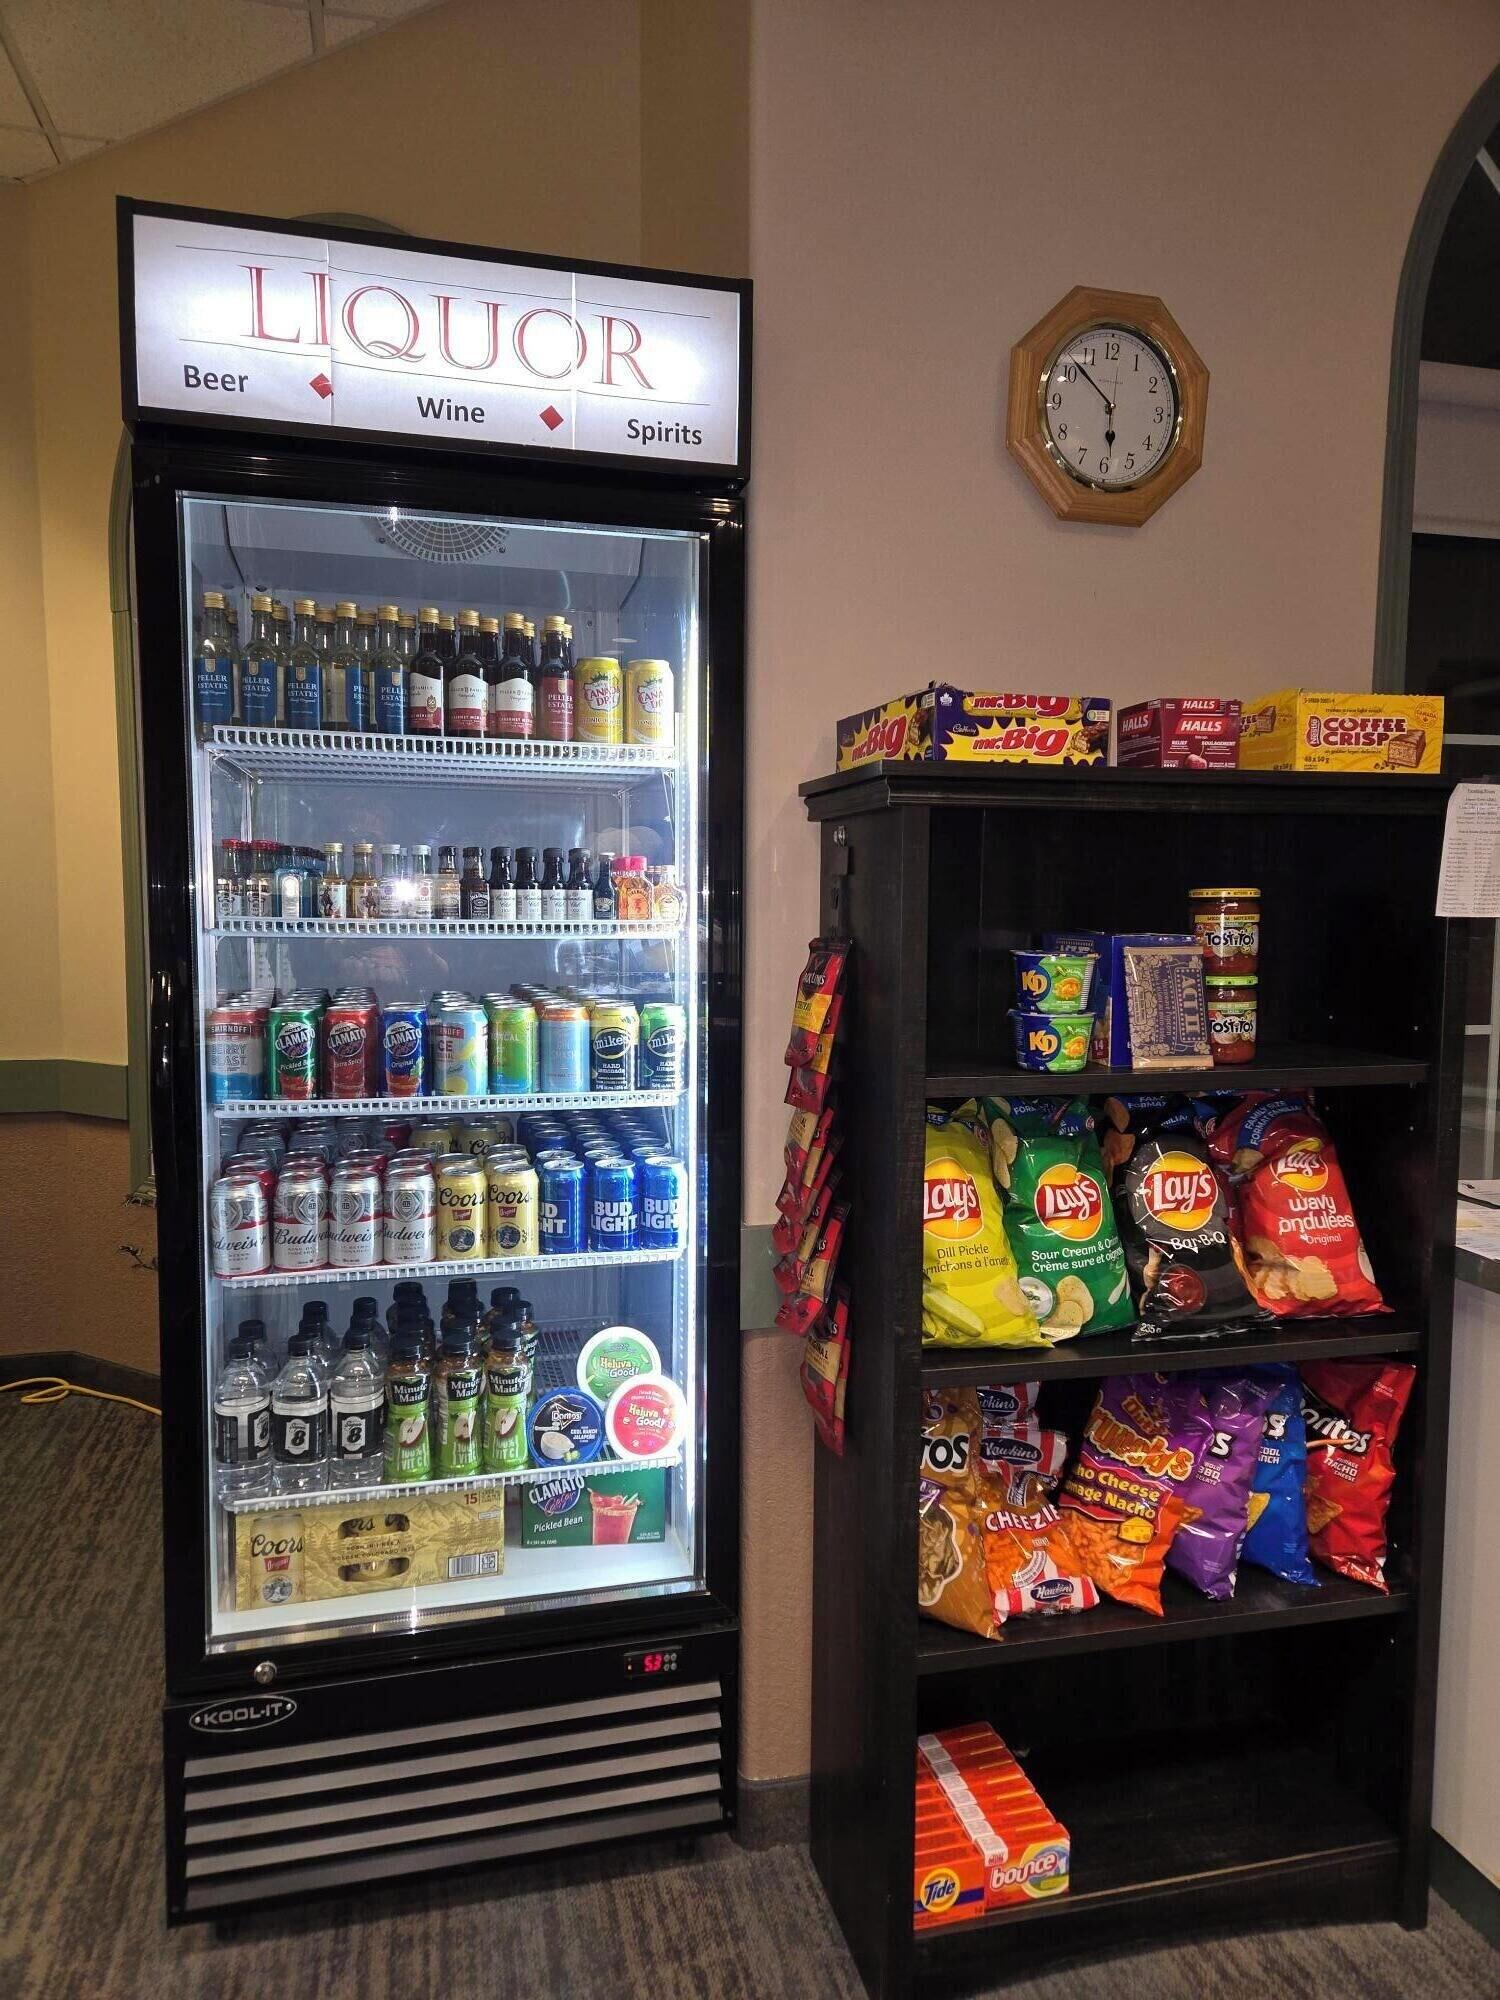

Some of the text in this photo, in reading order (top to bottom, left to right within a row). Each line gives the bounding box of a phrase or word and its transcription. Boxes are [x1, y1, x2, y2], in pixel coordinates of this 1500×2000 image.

[237, 265, 655, 390] LIQUOR
[1083, 348, 1096, 366] 11
[1105, 342, 1120, 360] 12
[1133, 354, 1139, 371] 1
[1063, 365, 1077, 383] 10
[1149, 377, 1158, 393] 2
[183, 364, 703, 446] Beer Wine Spirits
[1052, 393, 1062, 410] 9
[1153, 407, 1163, 423] 3
[1058, 423, 1068, 440] 8
[1142, 435, 1152, 450] 4
[1078, 448, 1087, 465] 7
[1125, 453, 1135, 469] 5
[1100, 457, 1109, 474] 6
[1182, 700, 1216, 709] HALLS
[952, 723, 978, 735] Cadbury
[1122, 714, 1150, 732] HALLS
[1180, 720, 1223, 732] HALLS
[1323, 717, 1406, 732] COFFEE
[1002, 726, 1070, 757] Big
[1322, 732, 1390, 746] CRISP
[1022, 970, 1048, 996] KD
[1181, 975, 1199, 1011] ACT
[275, 1028, 316, 1050] CLAMATO
[327, 1028, 366, 1048] CLAMATO
[383, 1028, 422, 1048] CLAMATO
[651, 1034, 676, 1048] mik
[1029, 1030, 1058, 1055] KD
[1244, 1102, 1267, 1130] FAMILY
[1250, 1113, 1273, 1146] FORMAT
[440, 1188, 484, 1207] Coors
[488, 1184, 530, 1204] Coors
[1044, 1178, 1098, 1221] Lay's
[1153, 1172, 1213, 1214] Lay's
[594, 1201, 632, 1218] BUD
[1288, 1196, 1336, 1216] wavy
[591, 1214, 637, 1232] LIGHT
[1278, 1212, 1355, 1236] ondulées
[1306, 1233, 1342, 1246] Original
[937, 1244, 990, 1260] Dill Pickle
[1032, 1250, 1060, 1261] Sour
[1062, 1245, 1096, 1258] Cream
[1098, 1240, 1104, 1250] &
[974, 1257, 982, 1268] à
[1032, 1260, 1069, 1273] Crème
[1072, 1258, 1095, 1269] sure
[1096, 1253, 1106, 1264] et
[600, 1357, 632, 1369] Heluva
[609, 1367, 640, 1378] Good!
[393, 1384, 428, 1394] Minute
[456, 1387, 478, 1398] Maid
[494, 1383, 518, 1393] Maid
[400, 1394, 423, 1402] Maid
[628, 1402, 659, 1418] Heluva
[636, 1416, 666, 1428] Good!
[291, 1430, 306, 1446] 8
[347, 1426, 362, 1443] 8
[1324, 1458, 1358, 1476] NACHO
[529, 1476, 585, 1504] CLAMATO
[1098, 1470, 1161, 1502] Cheese
[464, 1493, 478, 1505] 15
[1104, 1494, 1156, 1520] Nacho
[534, 1516, 584, 1533] Pickled Bean
[251, 1534, 304, 1559] Coors
[1036, 1582, 1074, 1598] Hawkins
[204, 1702, 284, 1726] KOOL-IT
[990, 1852, 1058, 1890] bounce
[924, 1878, 956, 1906] Tide
